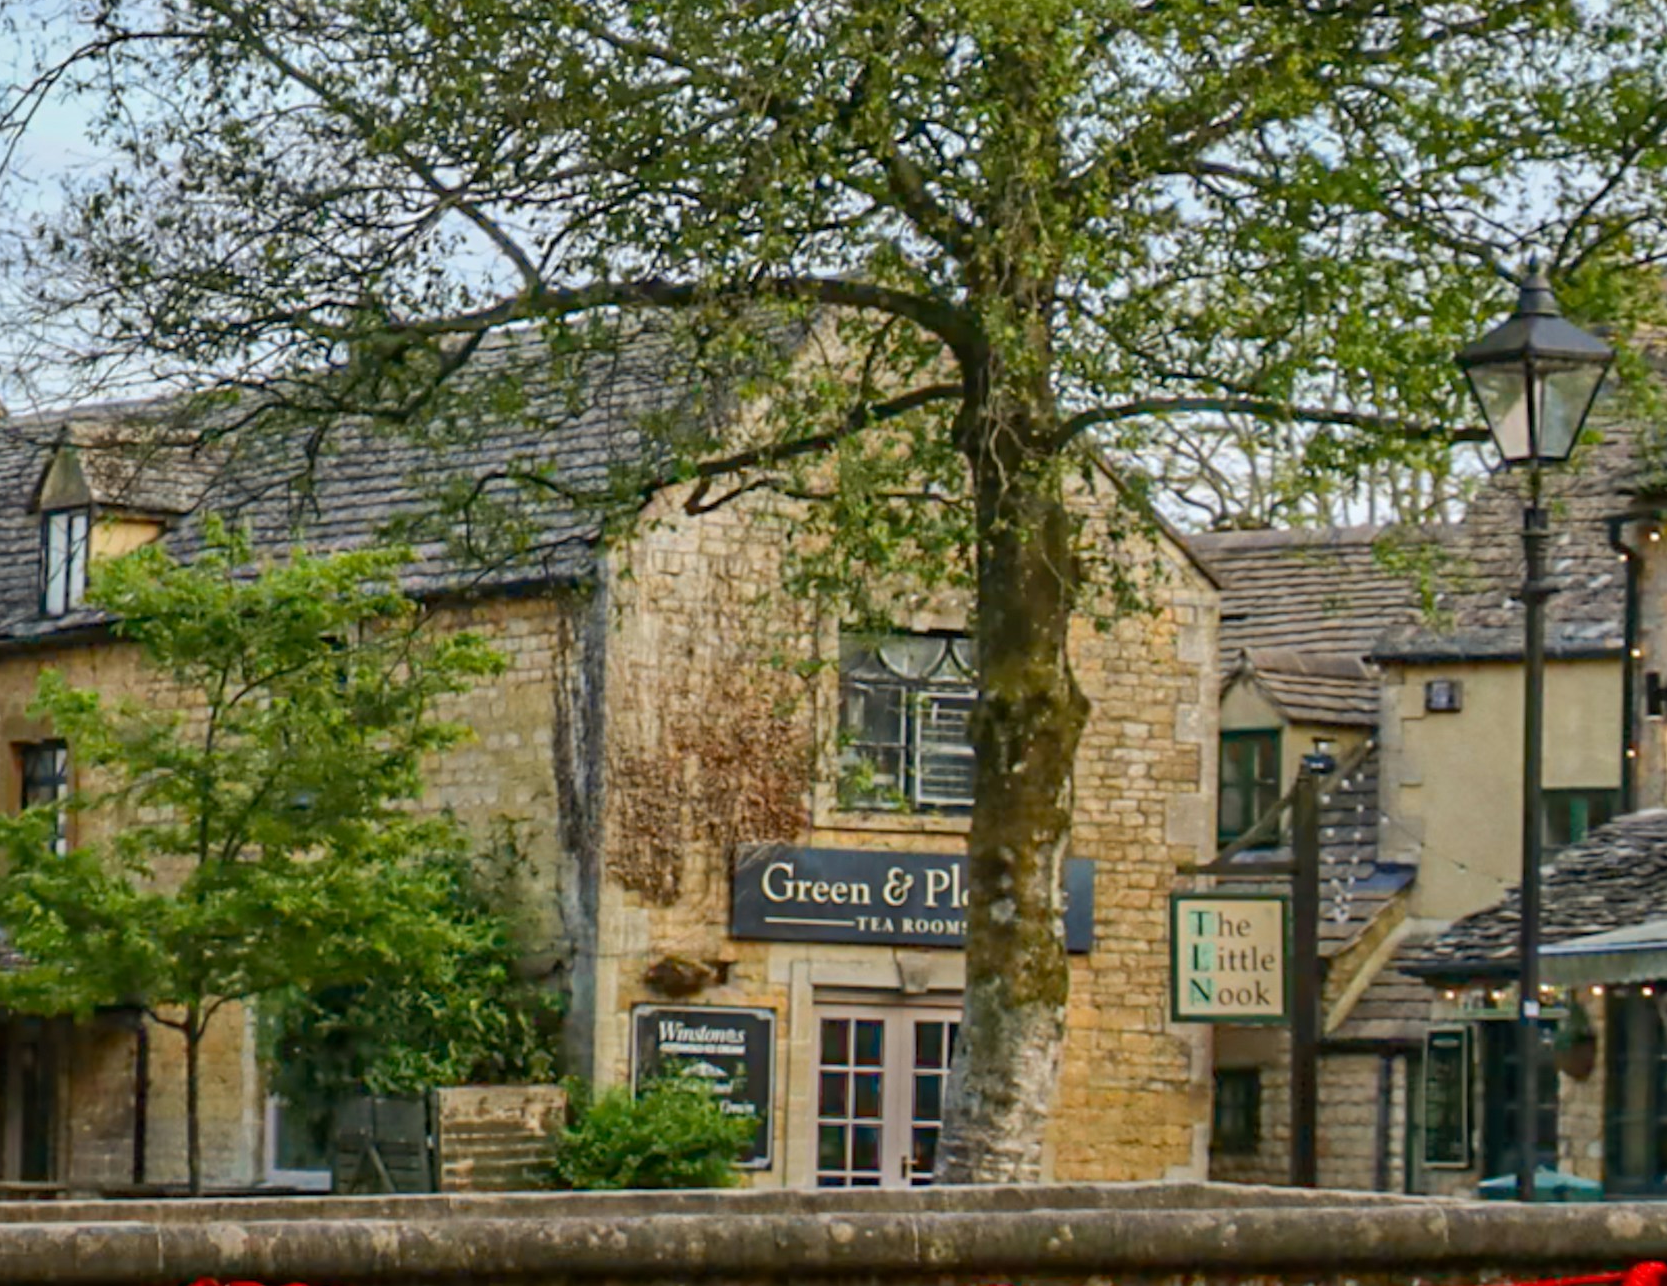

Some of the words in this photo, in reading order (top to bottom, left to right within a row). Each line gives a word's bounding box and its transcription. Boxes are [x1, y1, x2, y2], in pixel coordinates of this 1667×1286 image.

[761, 862, 871, 905] Green
[883, 866, 914, 906] &
[856, 916, 894, 933] TEA
[1189, 910, 1251, 938] The
[1190, 943, 1276, 972] Little
[1190, 978, 1271, 1006] Nook
